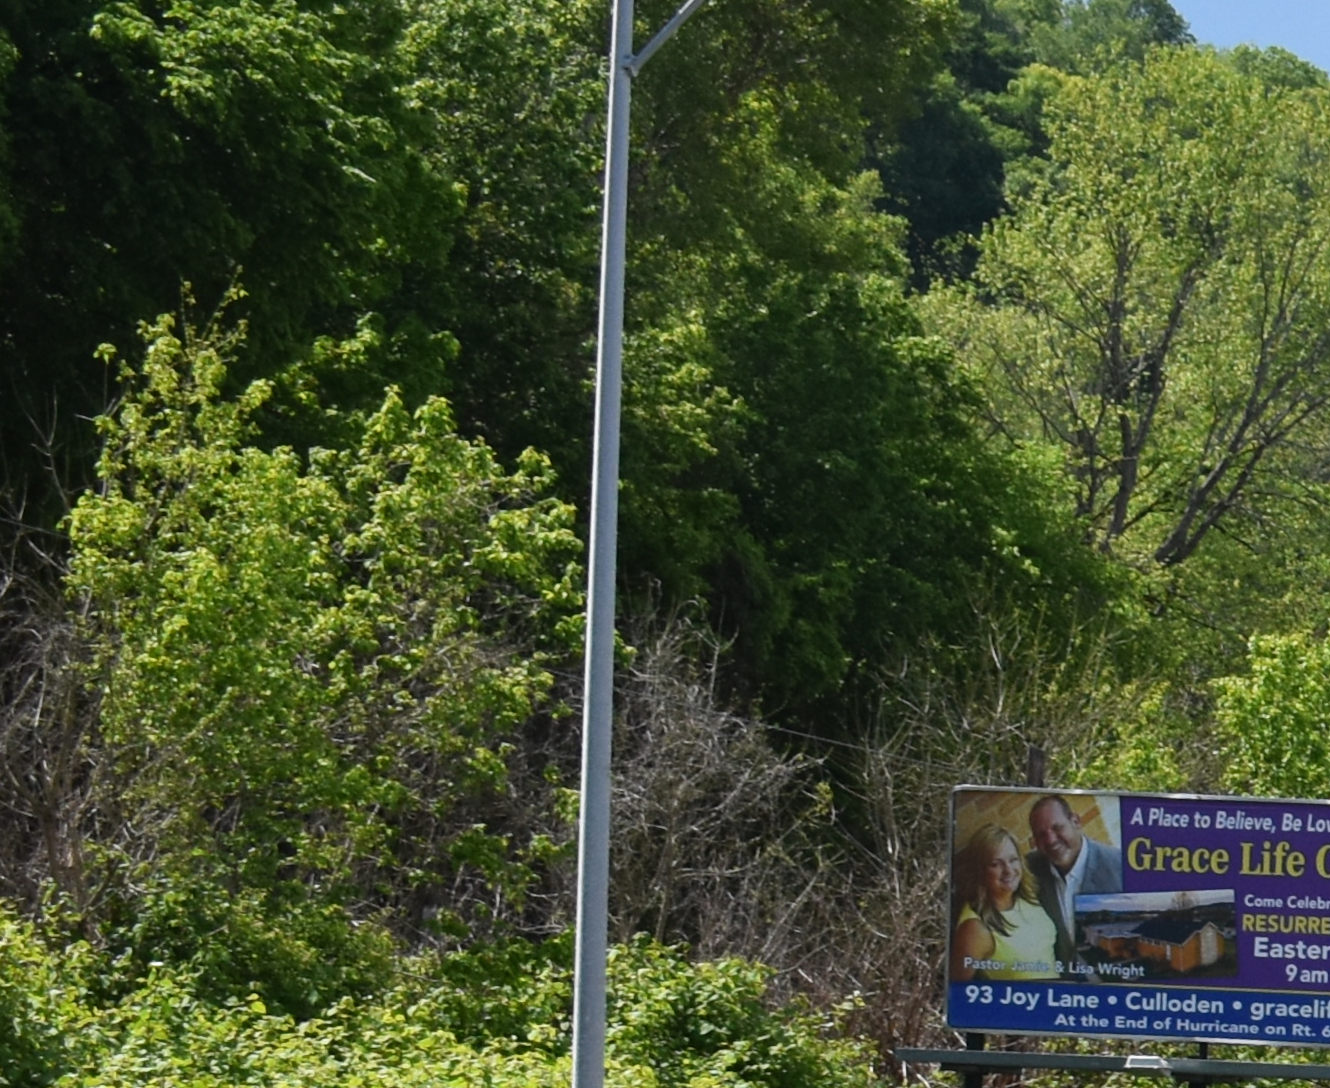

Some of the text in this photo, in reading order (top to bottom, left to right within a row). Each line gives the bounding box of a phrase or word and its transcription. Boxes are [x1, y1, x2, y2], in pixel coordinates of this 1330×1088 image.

[1130, 807, 1144, 825] A
[1148, 807, 1189, 828] Place
[1193, 811, 1211, 829] to
[1215, 810, 1276, 834] Believe,
[1281, 813, 1303, 832] Be
[1127, 836, 1230, 875] Grace
[1239, 840, 1306, 878] Life
[1244, 894, 1283, 909] Come
[963, 956, 1006, 971] Pastor
[1055, 961, 1065, 973] &
[1068, 961, 1095, 975] Lisa
[1097, 962, 1145, 980] Wright
[965, 984, 994, 1004] 93
[1000, 986, 1040, 1011] Joy
[1047, 988, 1100, 1009] Lane
[1125, 991, 1224, 1014] Culloden
[1054, 1013, 1076, 1026] At
[1080, 1014, 1109, 1028] the
[1114, 1015, 1148, 1030] End
[1153, 1016, 1173, 1031] of
[1176, 1018, 1259, 1034] Hurricane
[1264, 1025, 1287, 1036] on
[1292, 1023, 1316, 1037] Rt.
